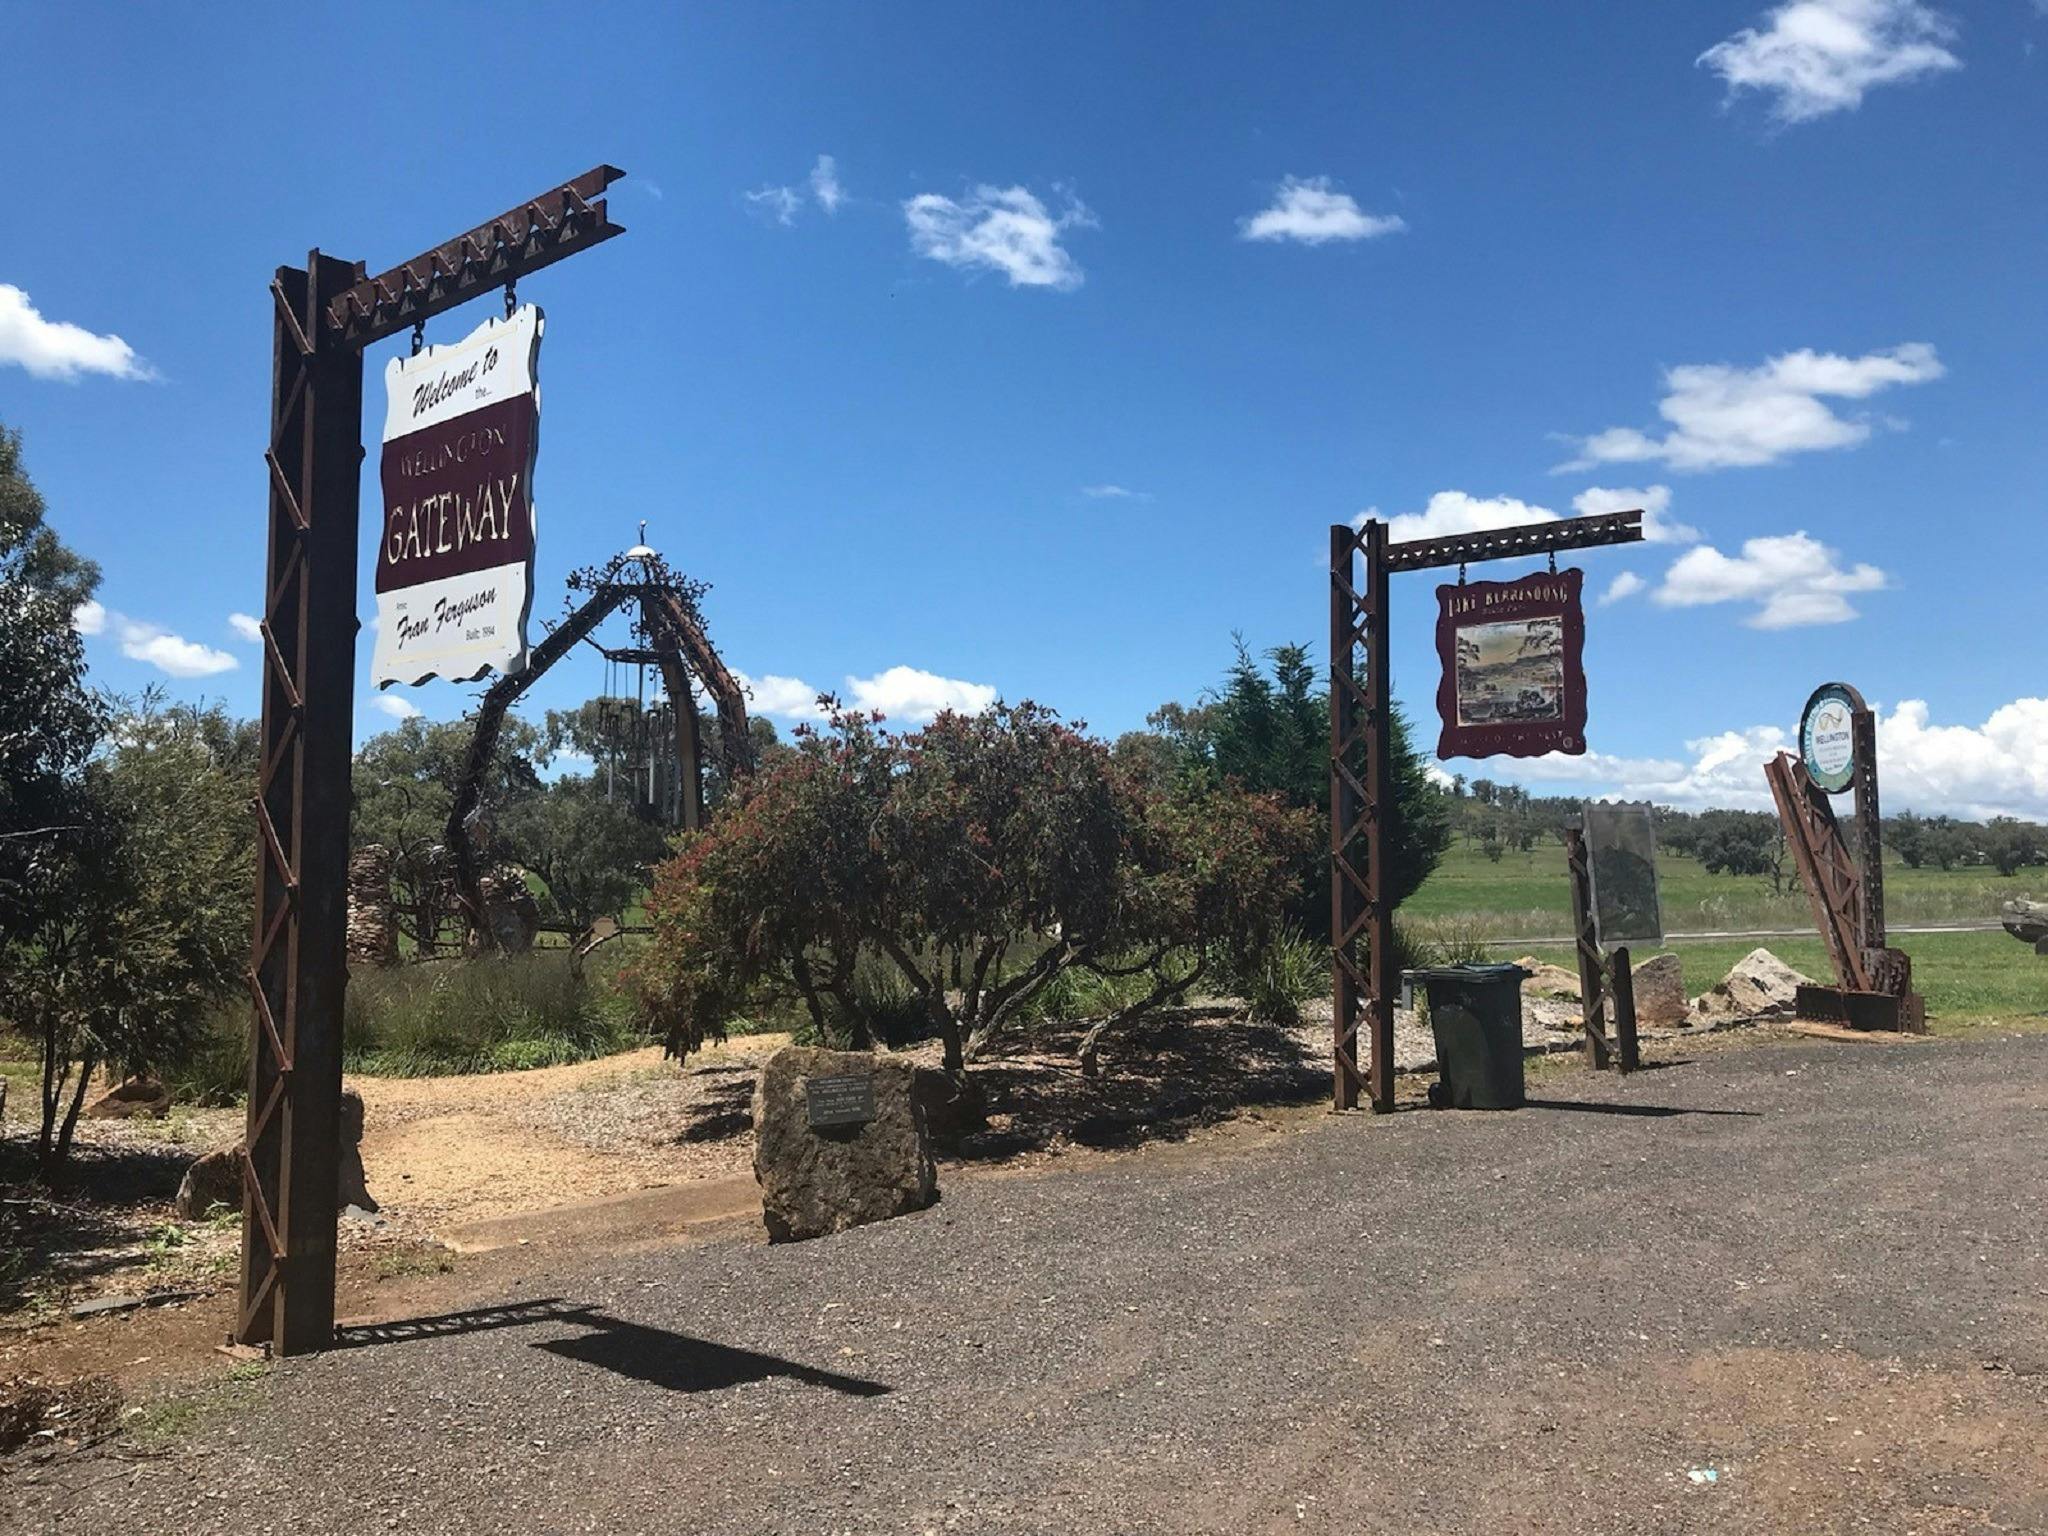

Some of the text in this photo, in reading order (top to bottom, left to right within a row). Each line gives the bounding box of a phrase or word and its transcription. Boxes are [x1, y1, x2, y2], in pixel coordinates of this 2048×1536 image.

[412, 344, 498, 419] Welcome to
[401, 424, 507, 477] WELLINGTON
[387, 471, 518, 566] GATEWAY
[396, 587, 497, 651] Fran Ferguson
[1815, 731, 1850, 745] WELLINGTON
